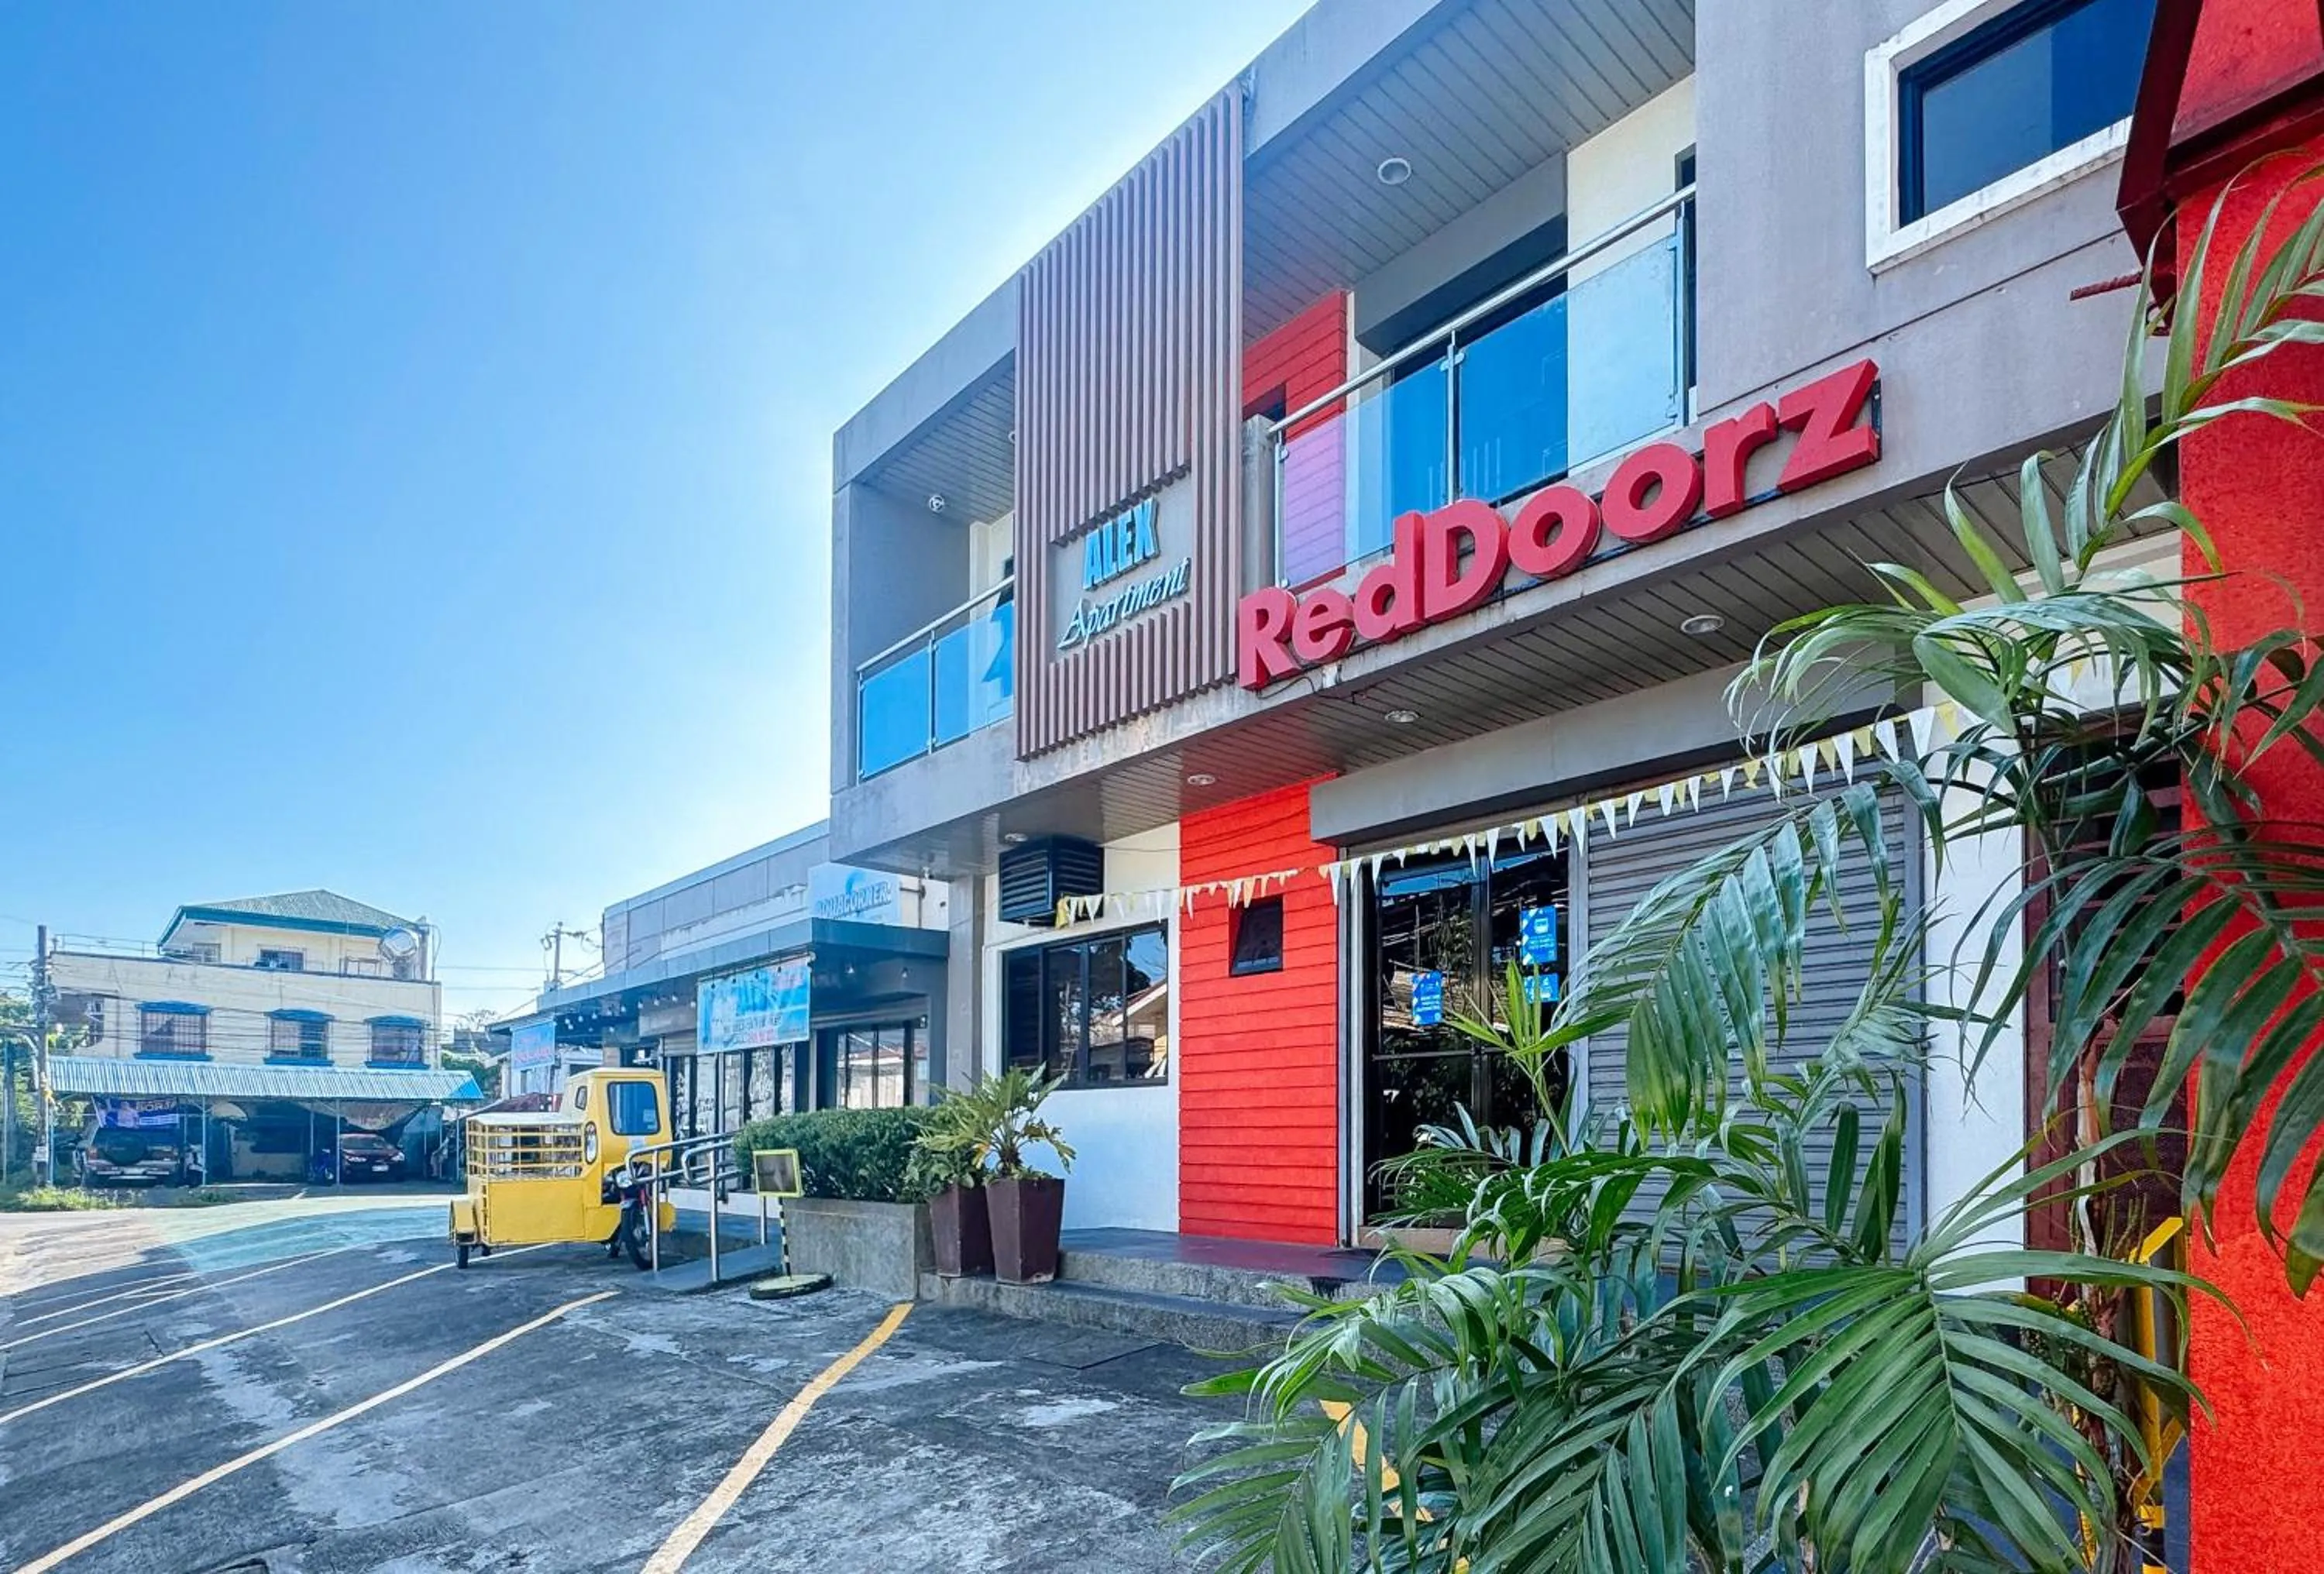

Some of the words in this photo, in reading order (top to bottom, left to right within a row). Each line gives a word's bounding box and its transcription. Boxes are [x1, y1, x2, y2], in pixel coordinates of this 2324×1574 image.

[1082, 497, 1160, 591] ALEX
[1239, 359, 1879, 691] RedDoorz
[1057, 556, 1191, 649] Apartment
